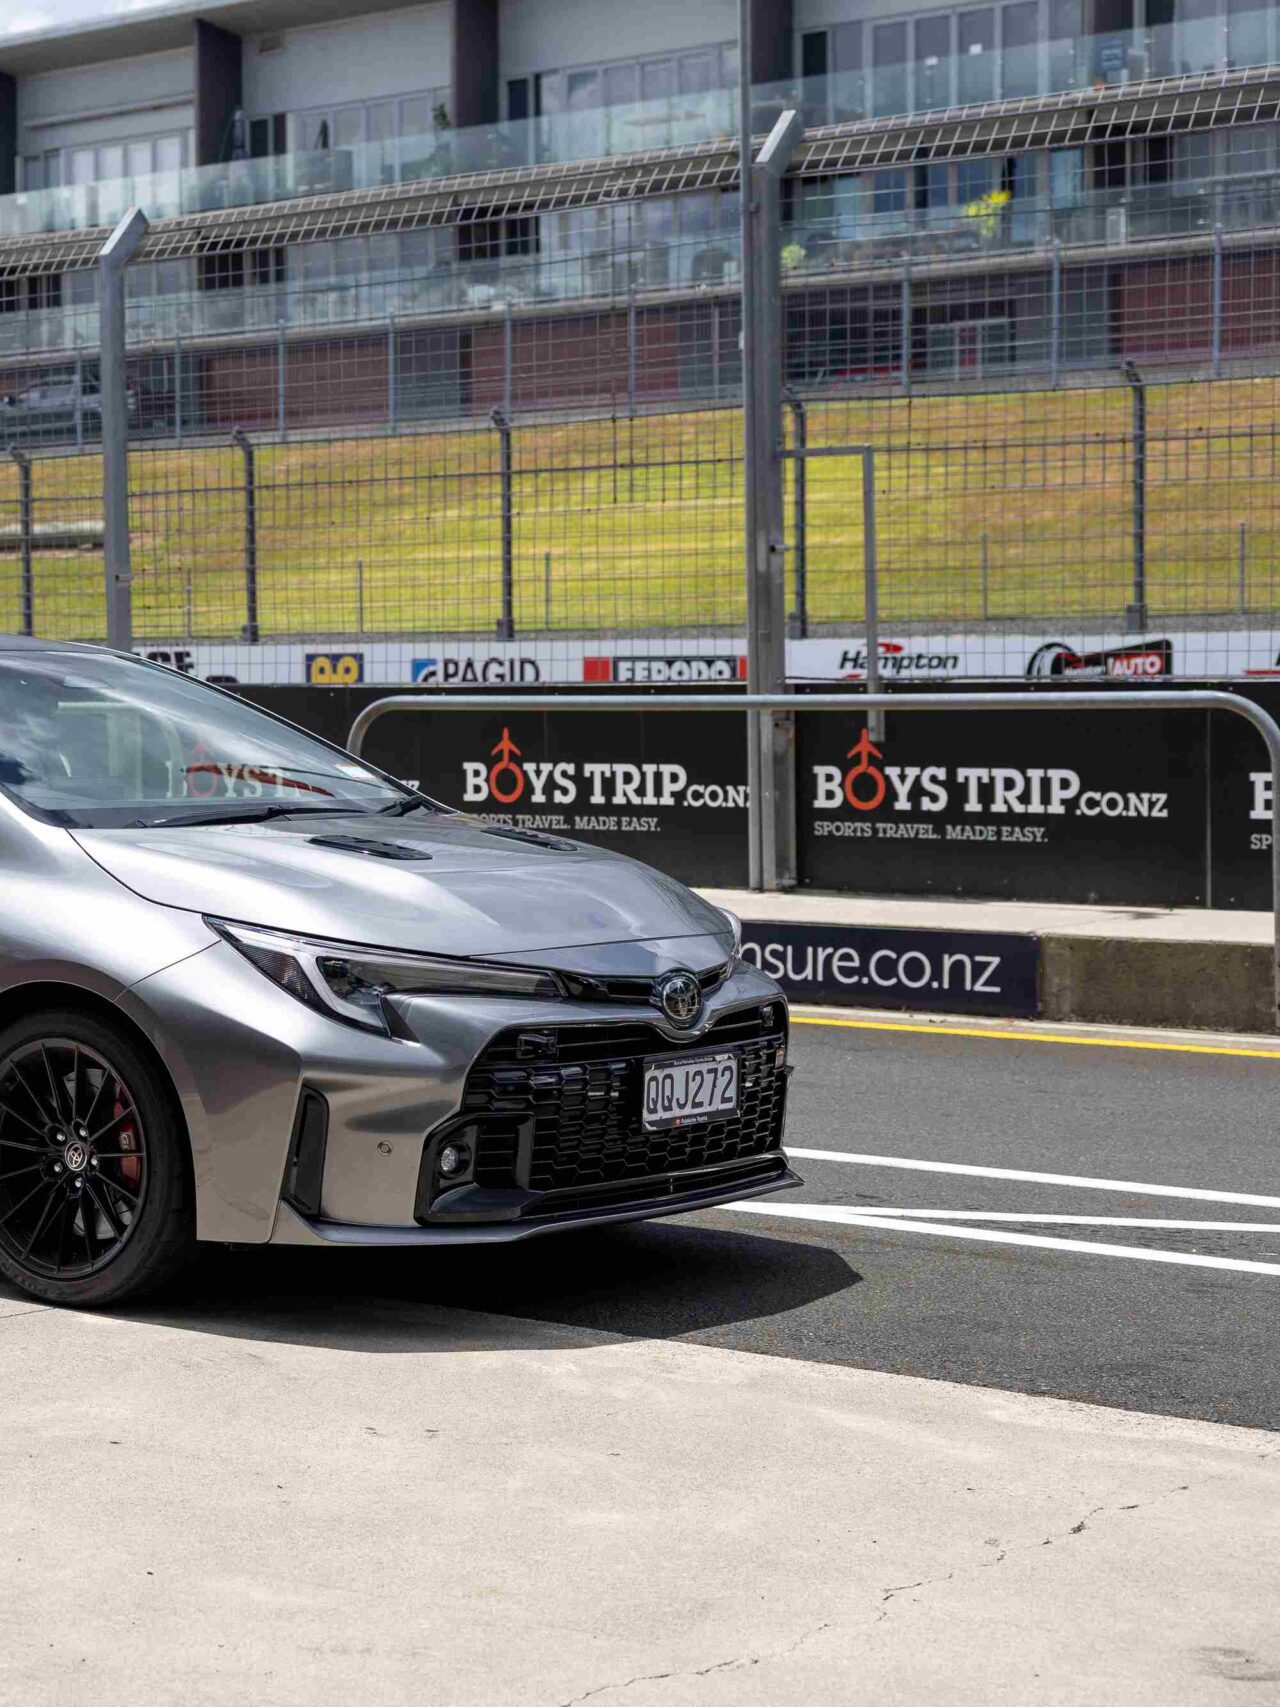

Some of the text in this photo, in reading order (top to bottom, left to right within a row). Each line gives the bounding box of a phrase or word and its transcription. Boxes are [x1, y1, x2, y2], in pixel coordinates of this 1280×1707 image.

[442, 657, 541, 683] PAGID
[618, 659, 732, 682] FERODO
[839, 650, 960, 674] Hampton
[463, 762, 575, 804] BOYS
[813, 766, 947, 811] BOYS
[516, 814, 571, 830] TRAVEL.
[574, 816, 618, 831] MADE
[621, 816, 661, 832] EASY.
[814, 821, 1049, 843] SPORTS TRAVEL. MADE EASY.
[646, 1065, 734, 1115] QQJ272
